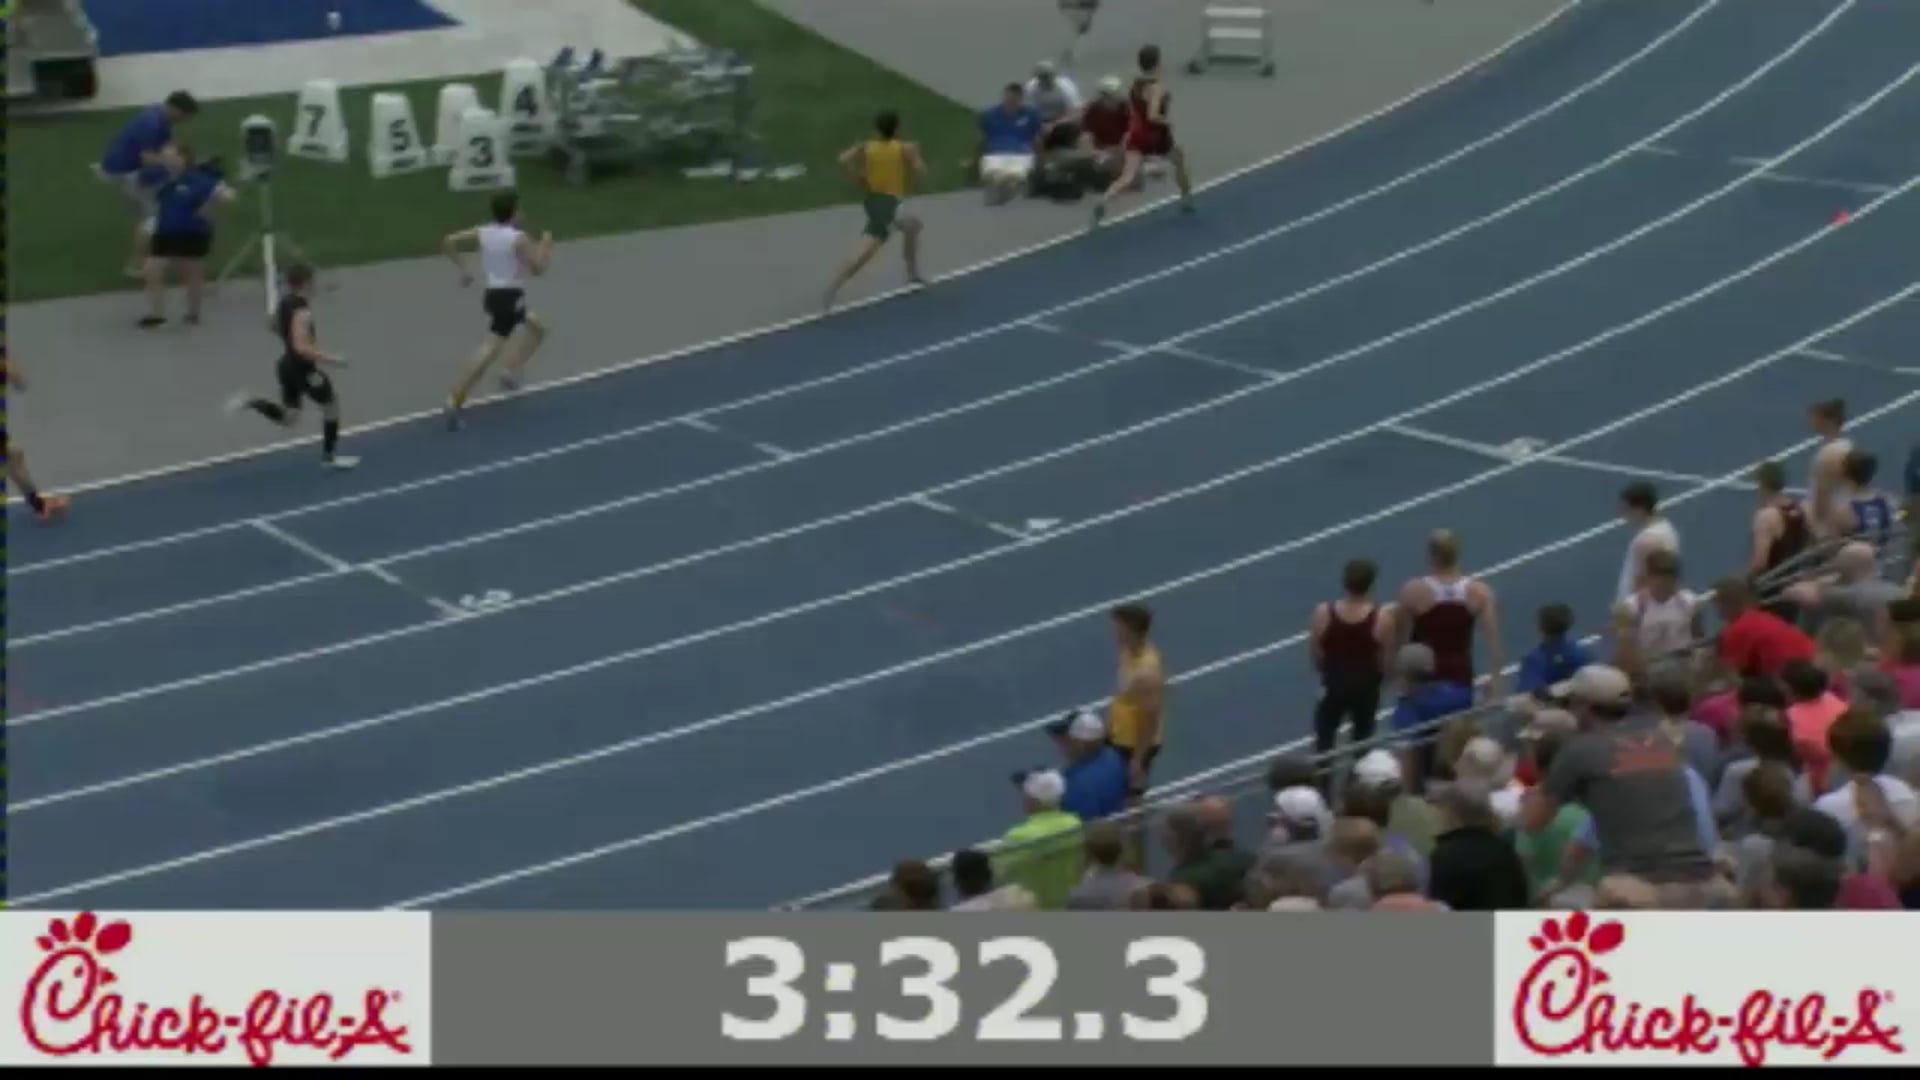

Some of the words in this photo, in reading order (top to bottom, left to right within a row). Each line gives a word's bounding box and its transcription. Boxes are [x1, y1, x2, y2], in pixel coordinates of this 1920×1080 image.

[514, 85, 538, 117] 4
[303, 104, 327, 138] 7
[389, 119, 411, 153] 5
[468, 136, 494, 169] 3
